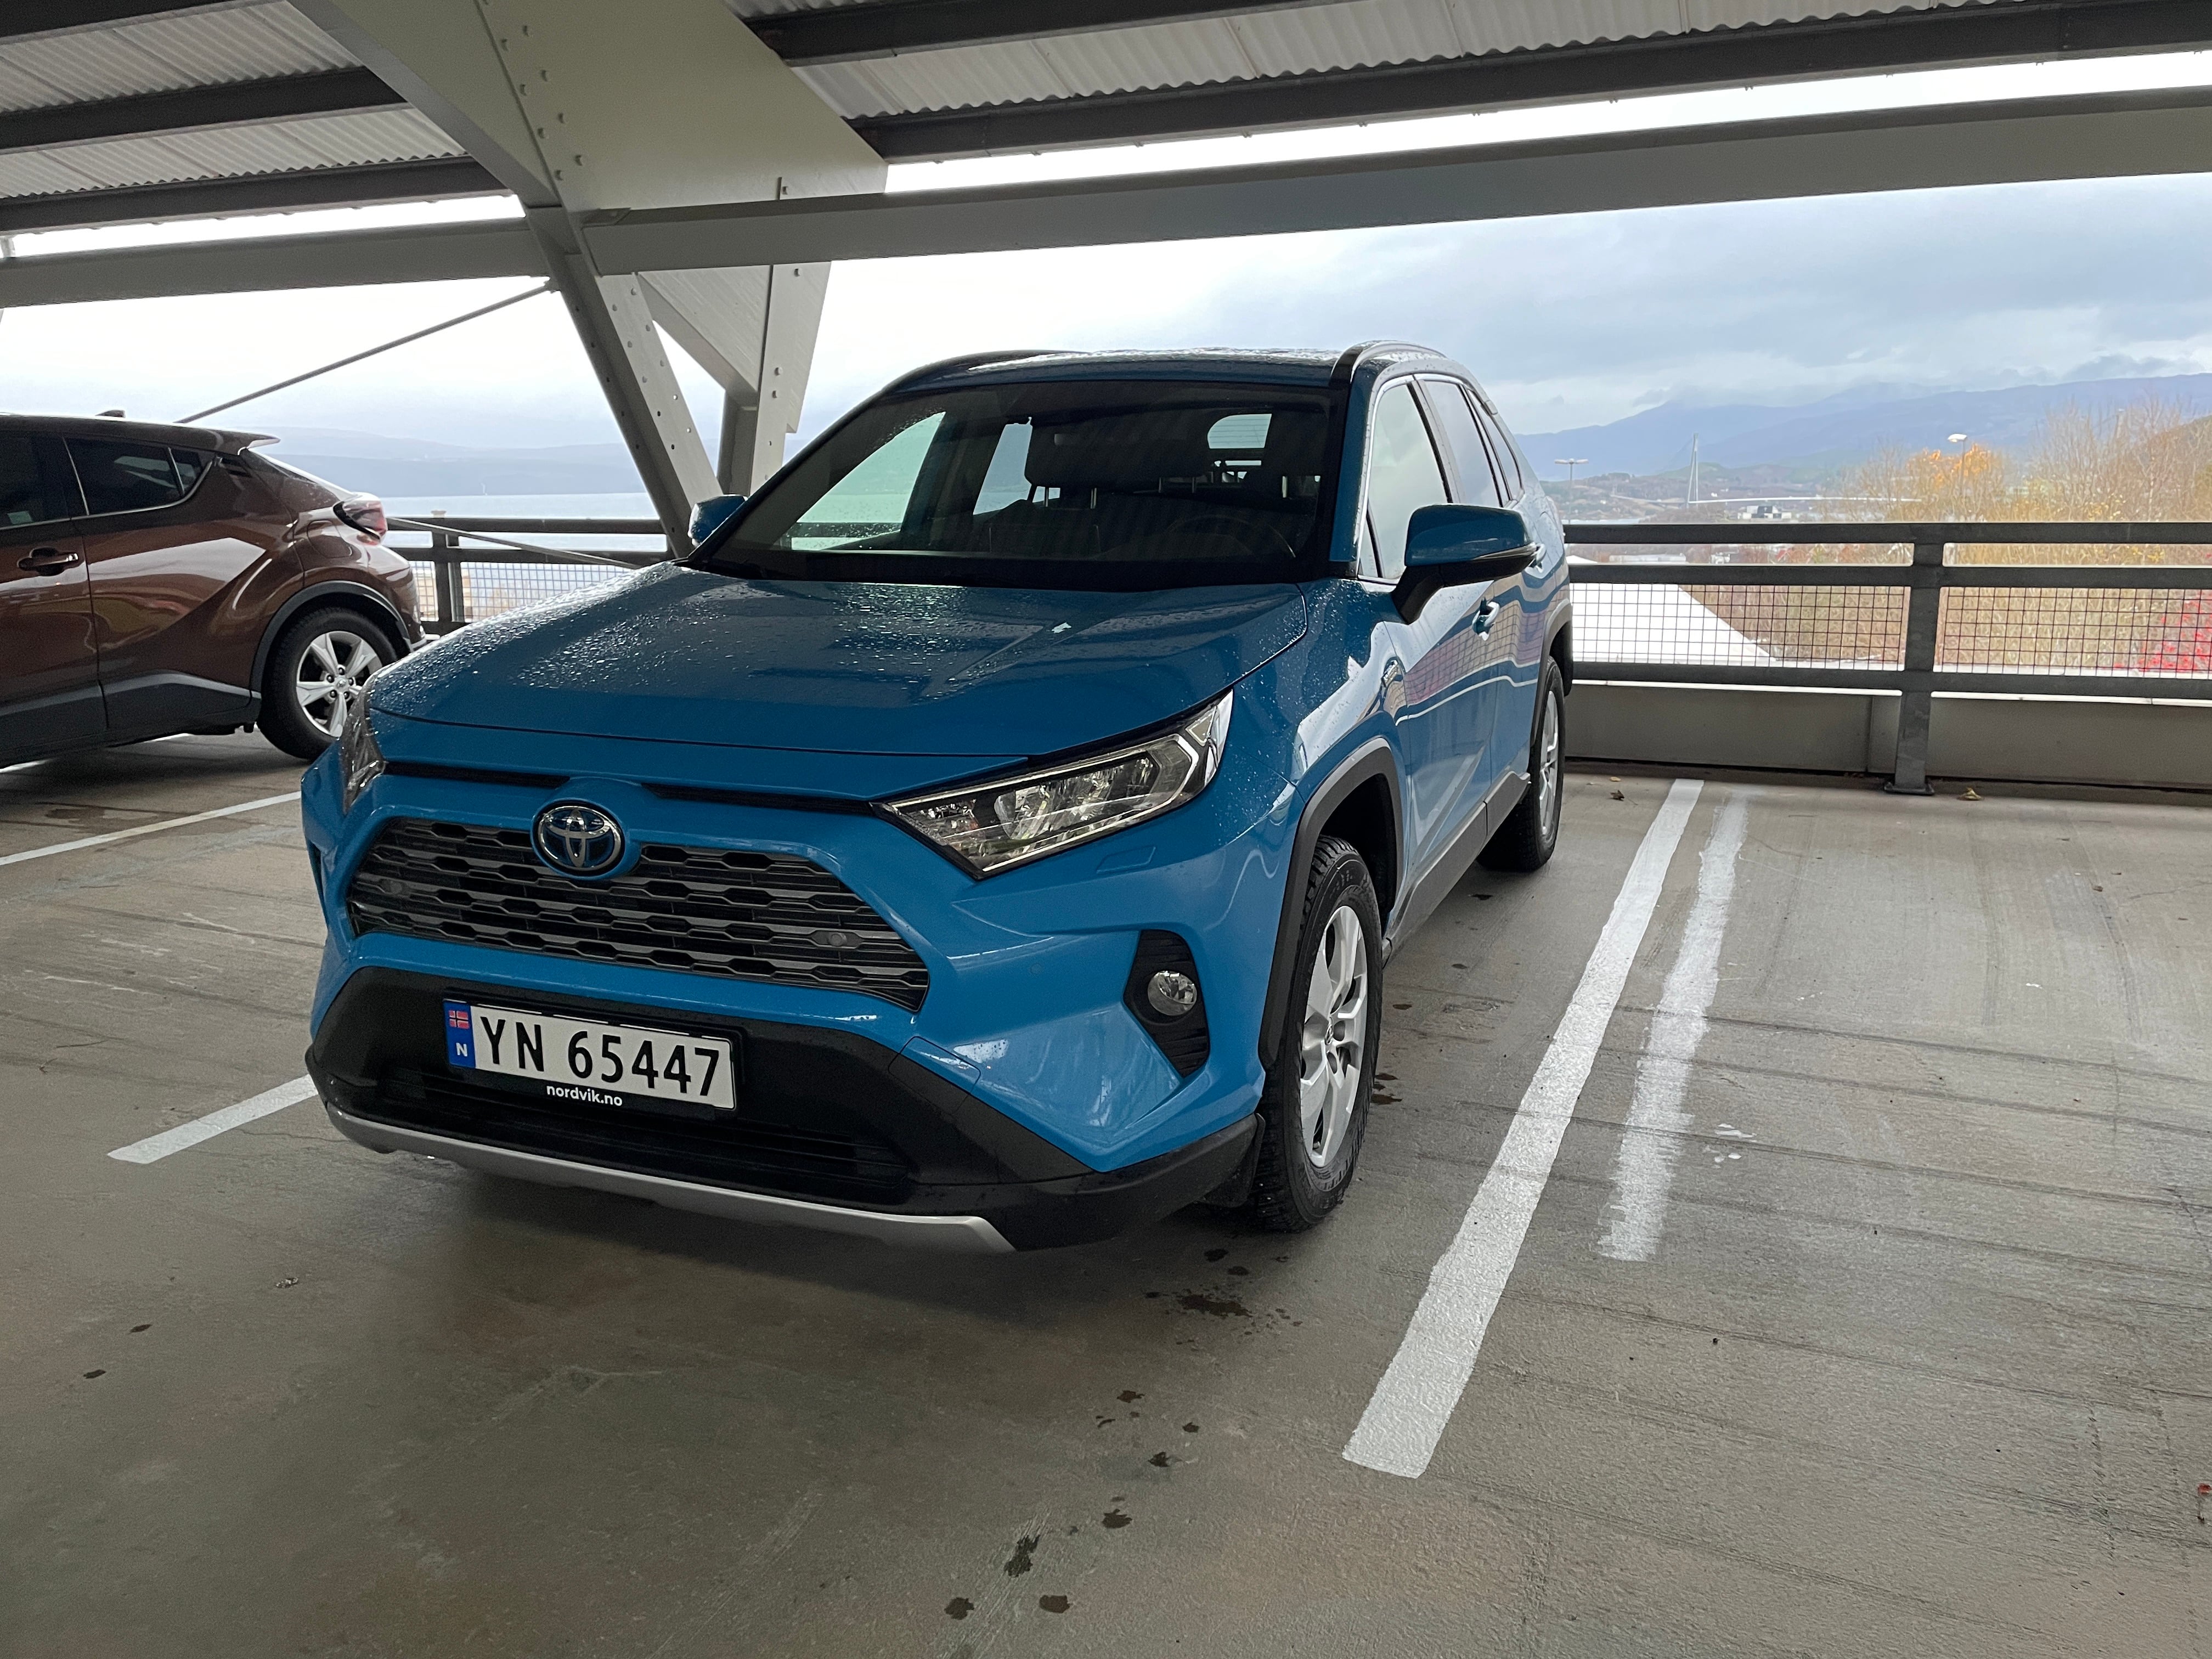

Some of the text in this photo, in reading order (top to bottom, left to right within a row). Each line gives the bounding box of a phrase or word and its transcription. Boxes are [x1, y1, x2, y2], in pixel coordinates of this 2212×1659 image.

[456, 1043, 468, 1057] N
[480, 1016, 719, 1096] YN 65447
[546, 1085, 622, 1107] nordvik.no
